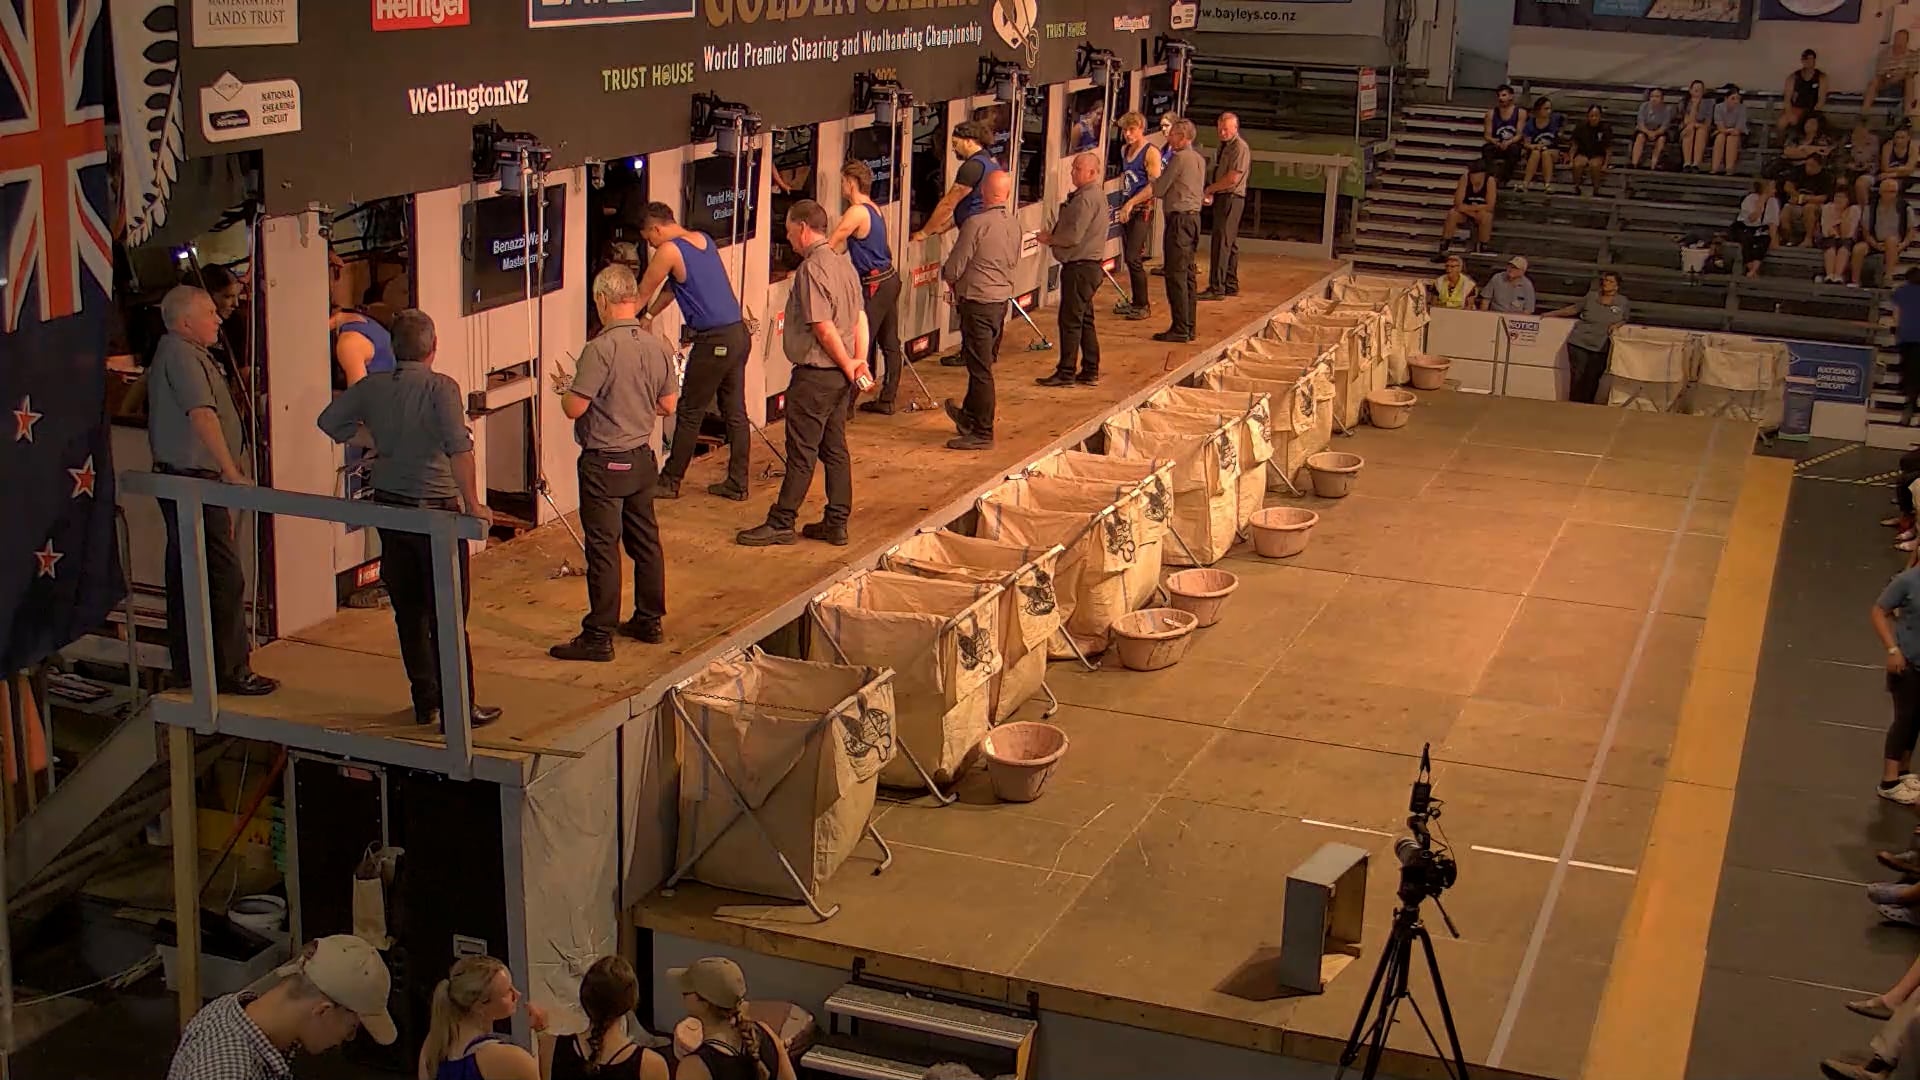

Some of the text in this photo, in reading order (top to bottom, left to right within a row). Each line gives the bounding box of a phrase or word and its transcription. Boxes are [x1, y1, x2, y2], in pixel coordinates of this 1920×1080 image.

[208, 10, 285, 25] LANDS TRUST
[376, 0, 464, 24] Heiniger
[1046, 21, 1087, 39] TRUST HOUSE
[703, 20, 982, 72] World Premier Shearing and Woolhandling Championship
[602, 62, 694, 91] TRUST HOUSE
[262, 90, 295, 101] NATIONAL
[408, 79, 529, 115] WellingtonNZ
[262, 101, 295, 113] SHEARING
[262, 113, 288, 125] CIRCUIT
[706, 189, 725, 206] David
[476, 289, 480, 303] 1
[1817, 366, 1856, 376] NATIONAL
[1816, 381, 1846, 390] CIRCUIT
